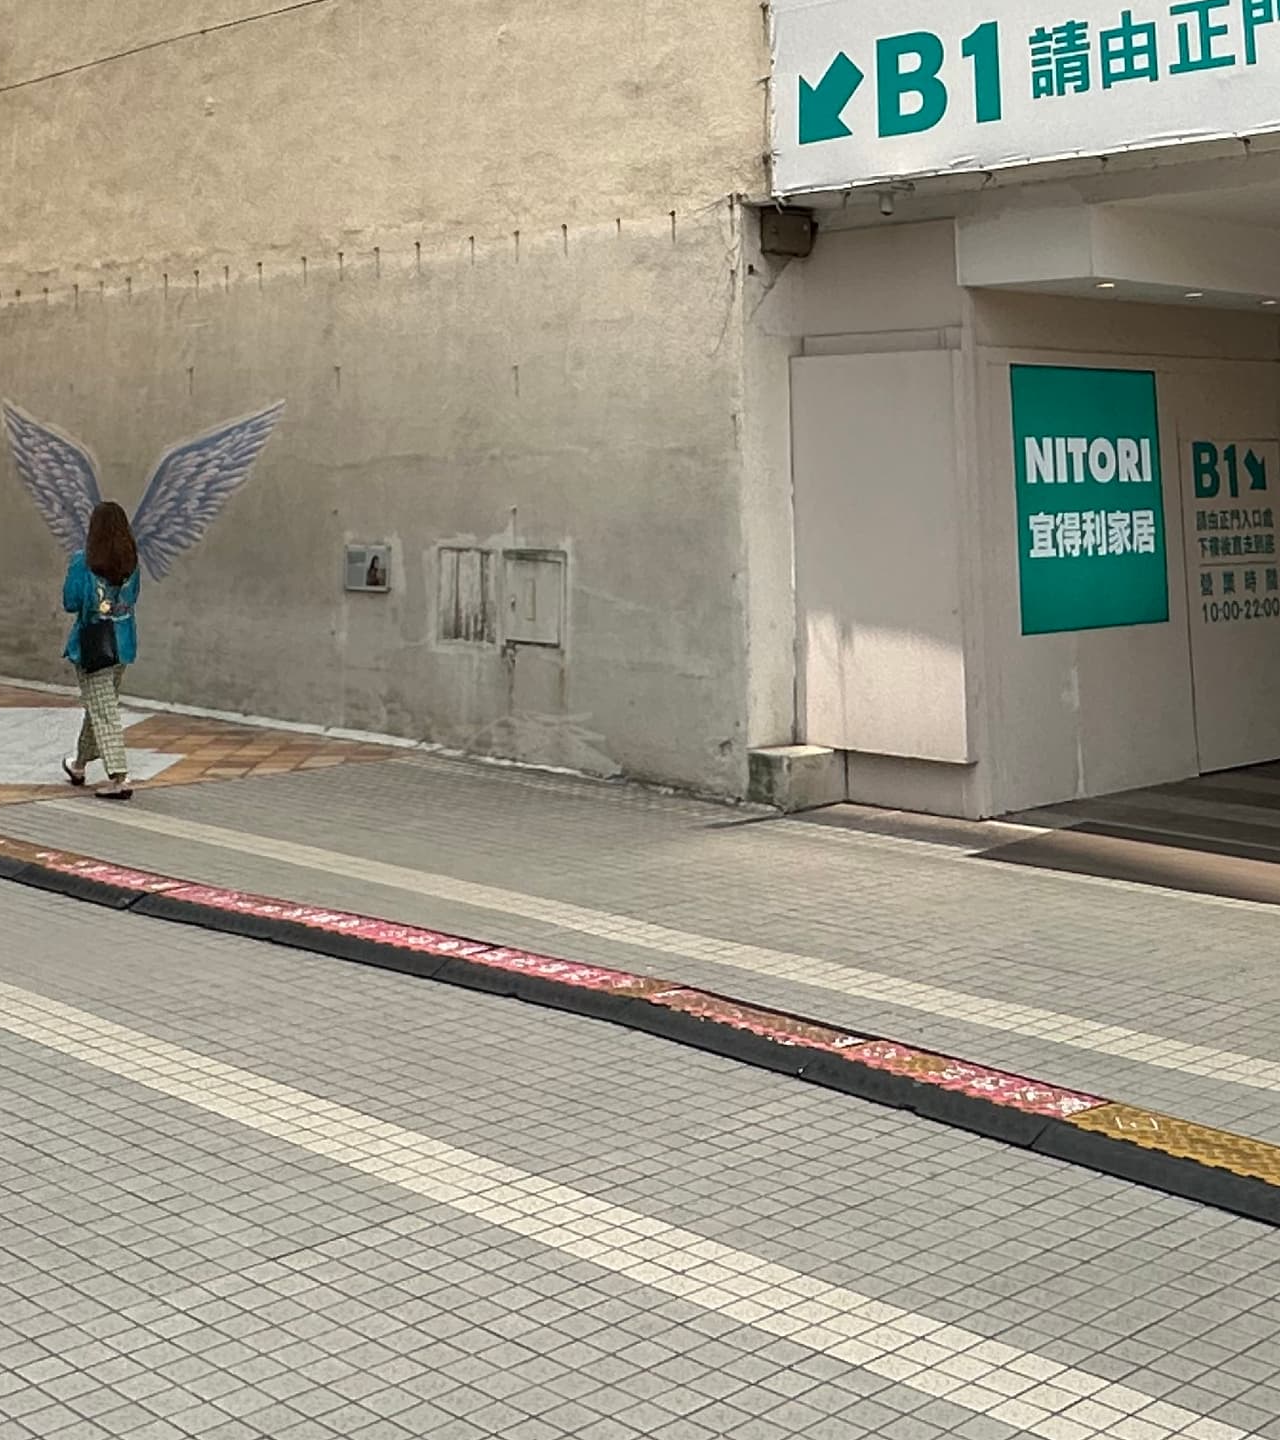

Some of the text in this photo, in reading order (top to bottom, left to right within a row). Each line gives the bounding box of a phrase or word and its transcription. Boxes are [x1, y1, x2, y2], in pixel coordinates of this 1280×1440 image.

[876, 20, 1002, 139] B1
[1024, 436, 1153, 484] NITORI
[1191, 441, 1240, 499] B1
[1028, 509, 1156, 559] 宜得利家居
[1201, 597, 1280, 624] 10:00-22:00
